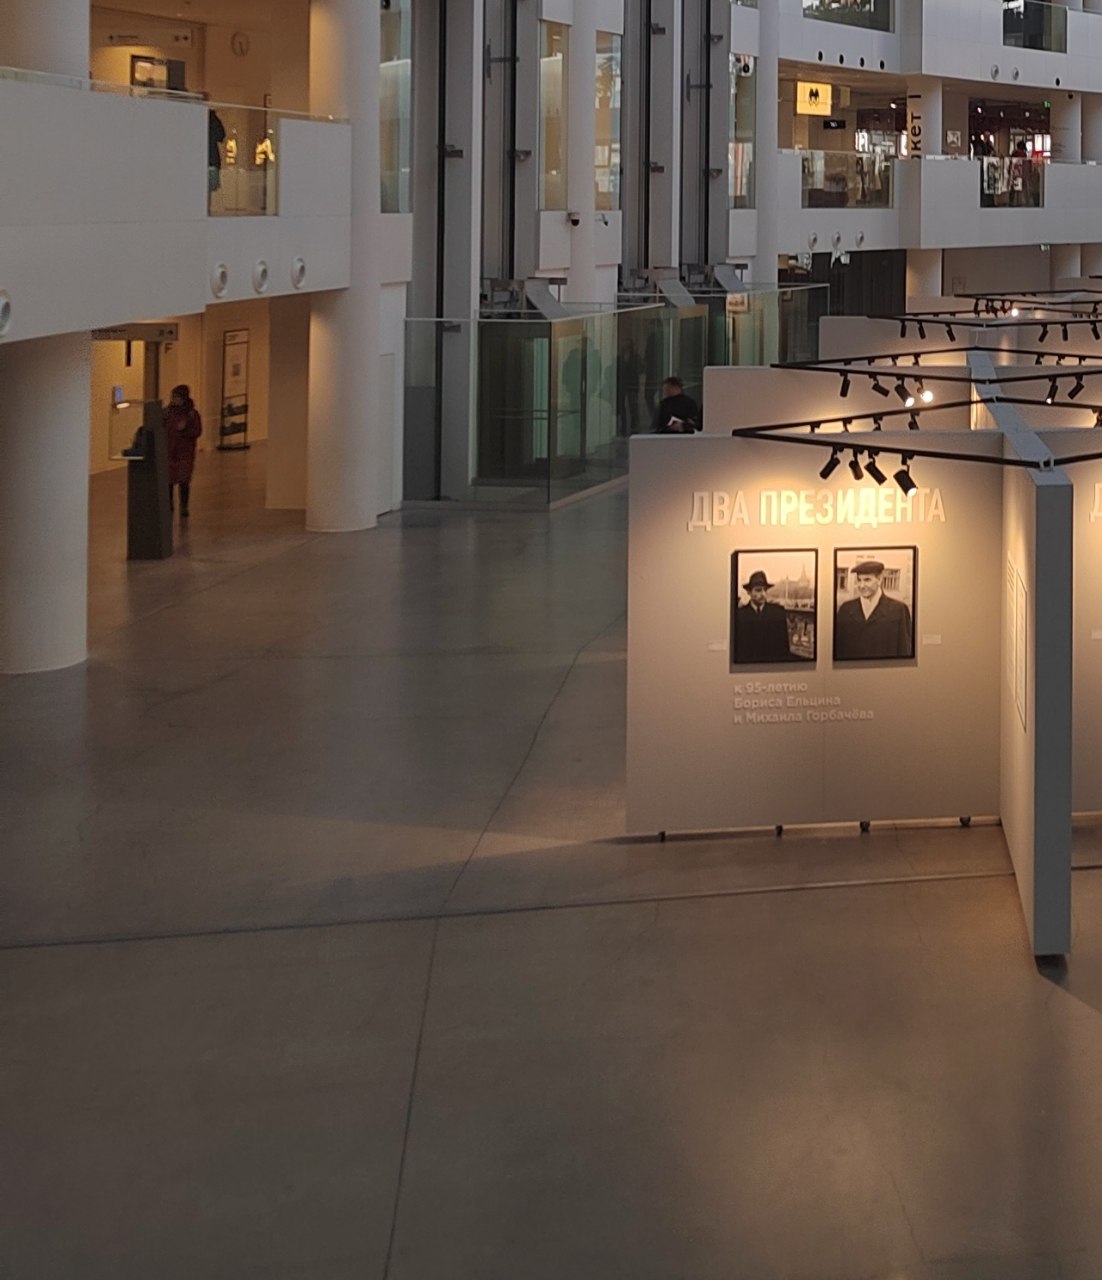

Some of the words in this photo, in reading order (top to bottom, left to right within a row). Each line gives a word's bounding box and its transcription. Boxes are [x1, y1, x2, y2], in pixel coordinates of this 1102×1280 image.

[687, 489, 751, 532] ДВА
[759, 487, 947, 529] ПРЕЗИДЕНТА
[733, 684, 743, 695] к
[745, 681, 808, 695] 95-летию
[733, 697, 784, 711] Бориса
[786, 695, 842, 709] Ельцина
[733, 714, 743, 725] и
[745, 711, 802, 726] Михаила
[806, 708, 875, 723] Горбачёва
